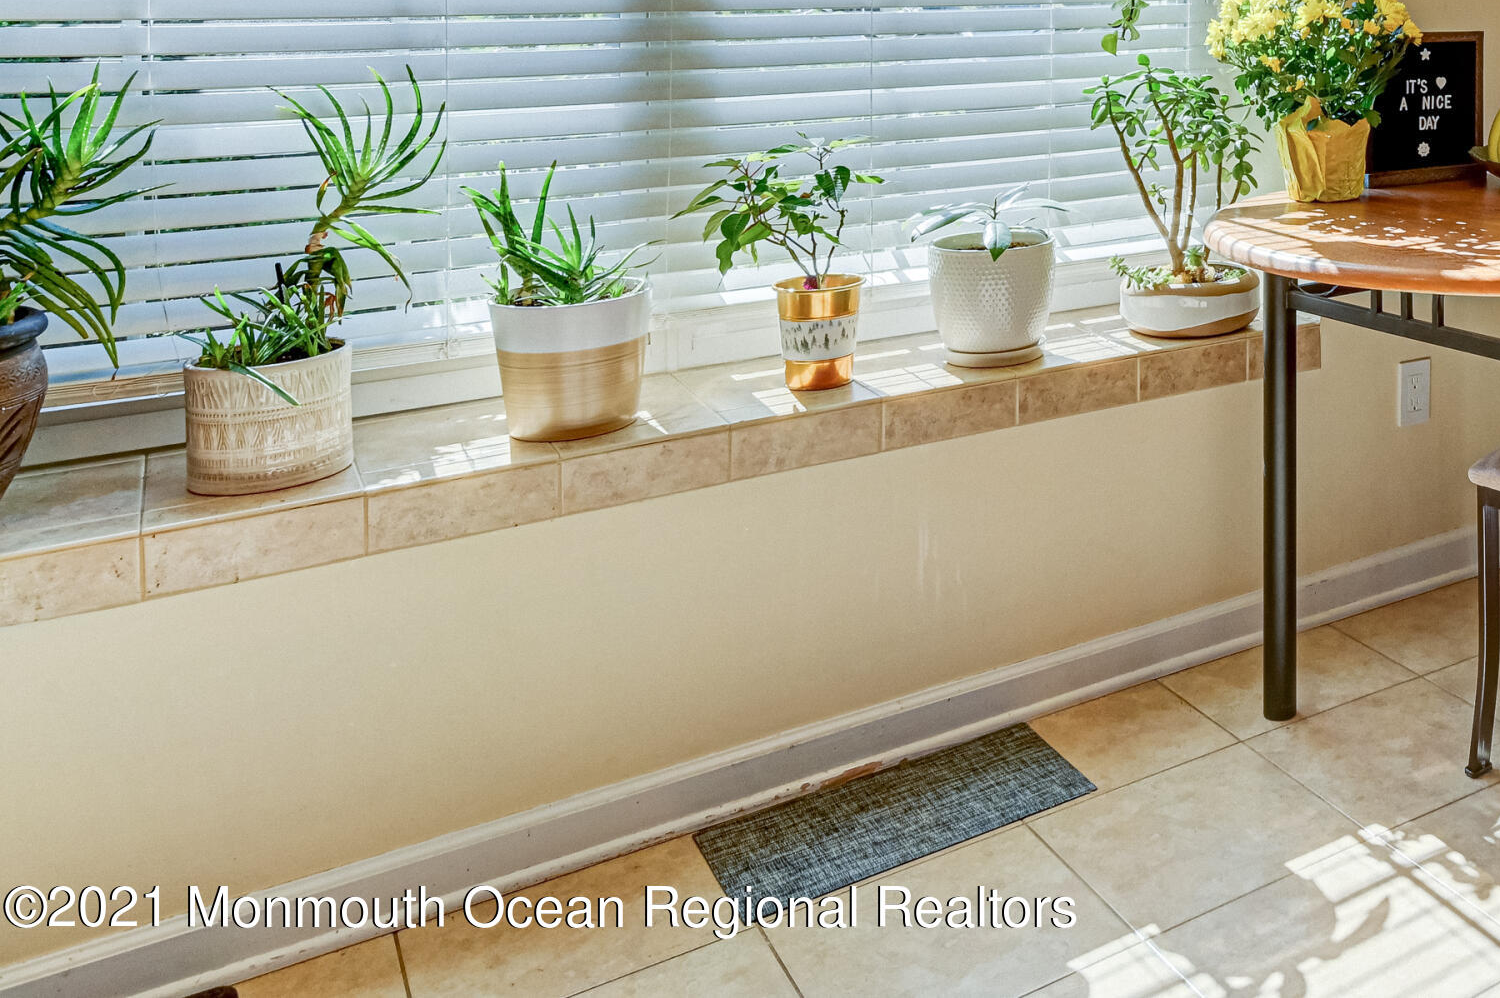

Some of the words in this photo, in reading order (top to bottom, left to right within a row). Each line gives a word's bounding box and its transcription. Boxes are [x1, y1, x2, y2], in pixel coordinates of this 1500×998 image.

[1405, 78, 1429, 95] IT'S
[1399, 96, 1408, 112] A
[1421, 95, 1452, 111] NICE
[1418, 115, 1440, 130] DAY
